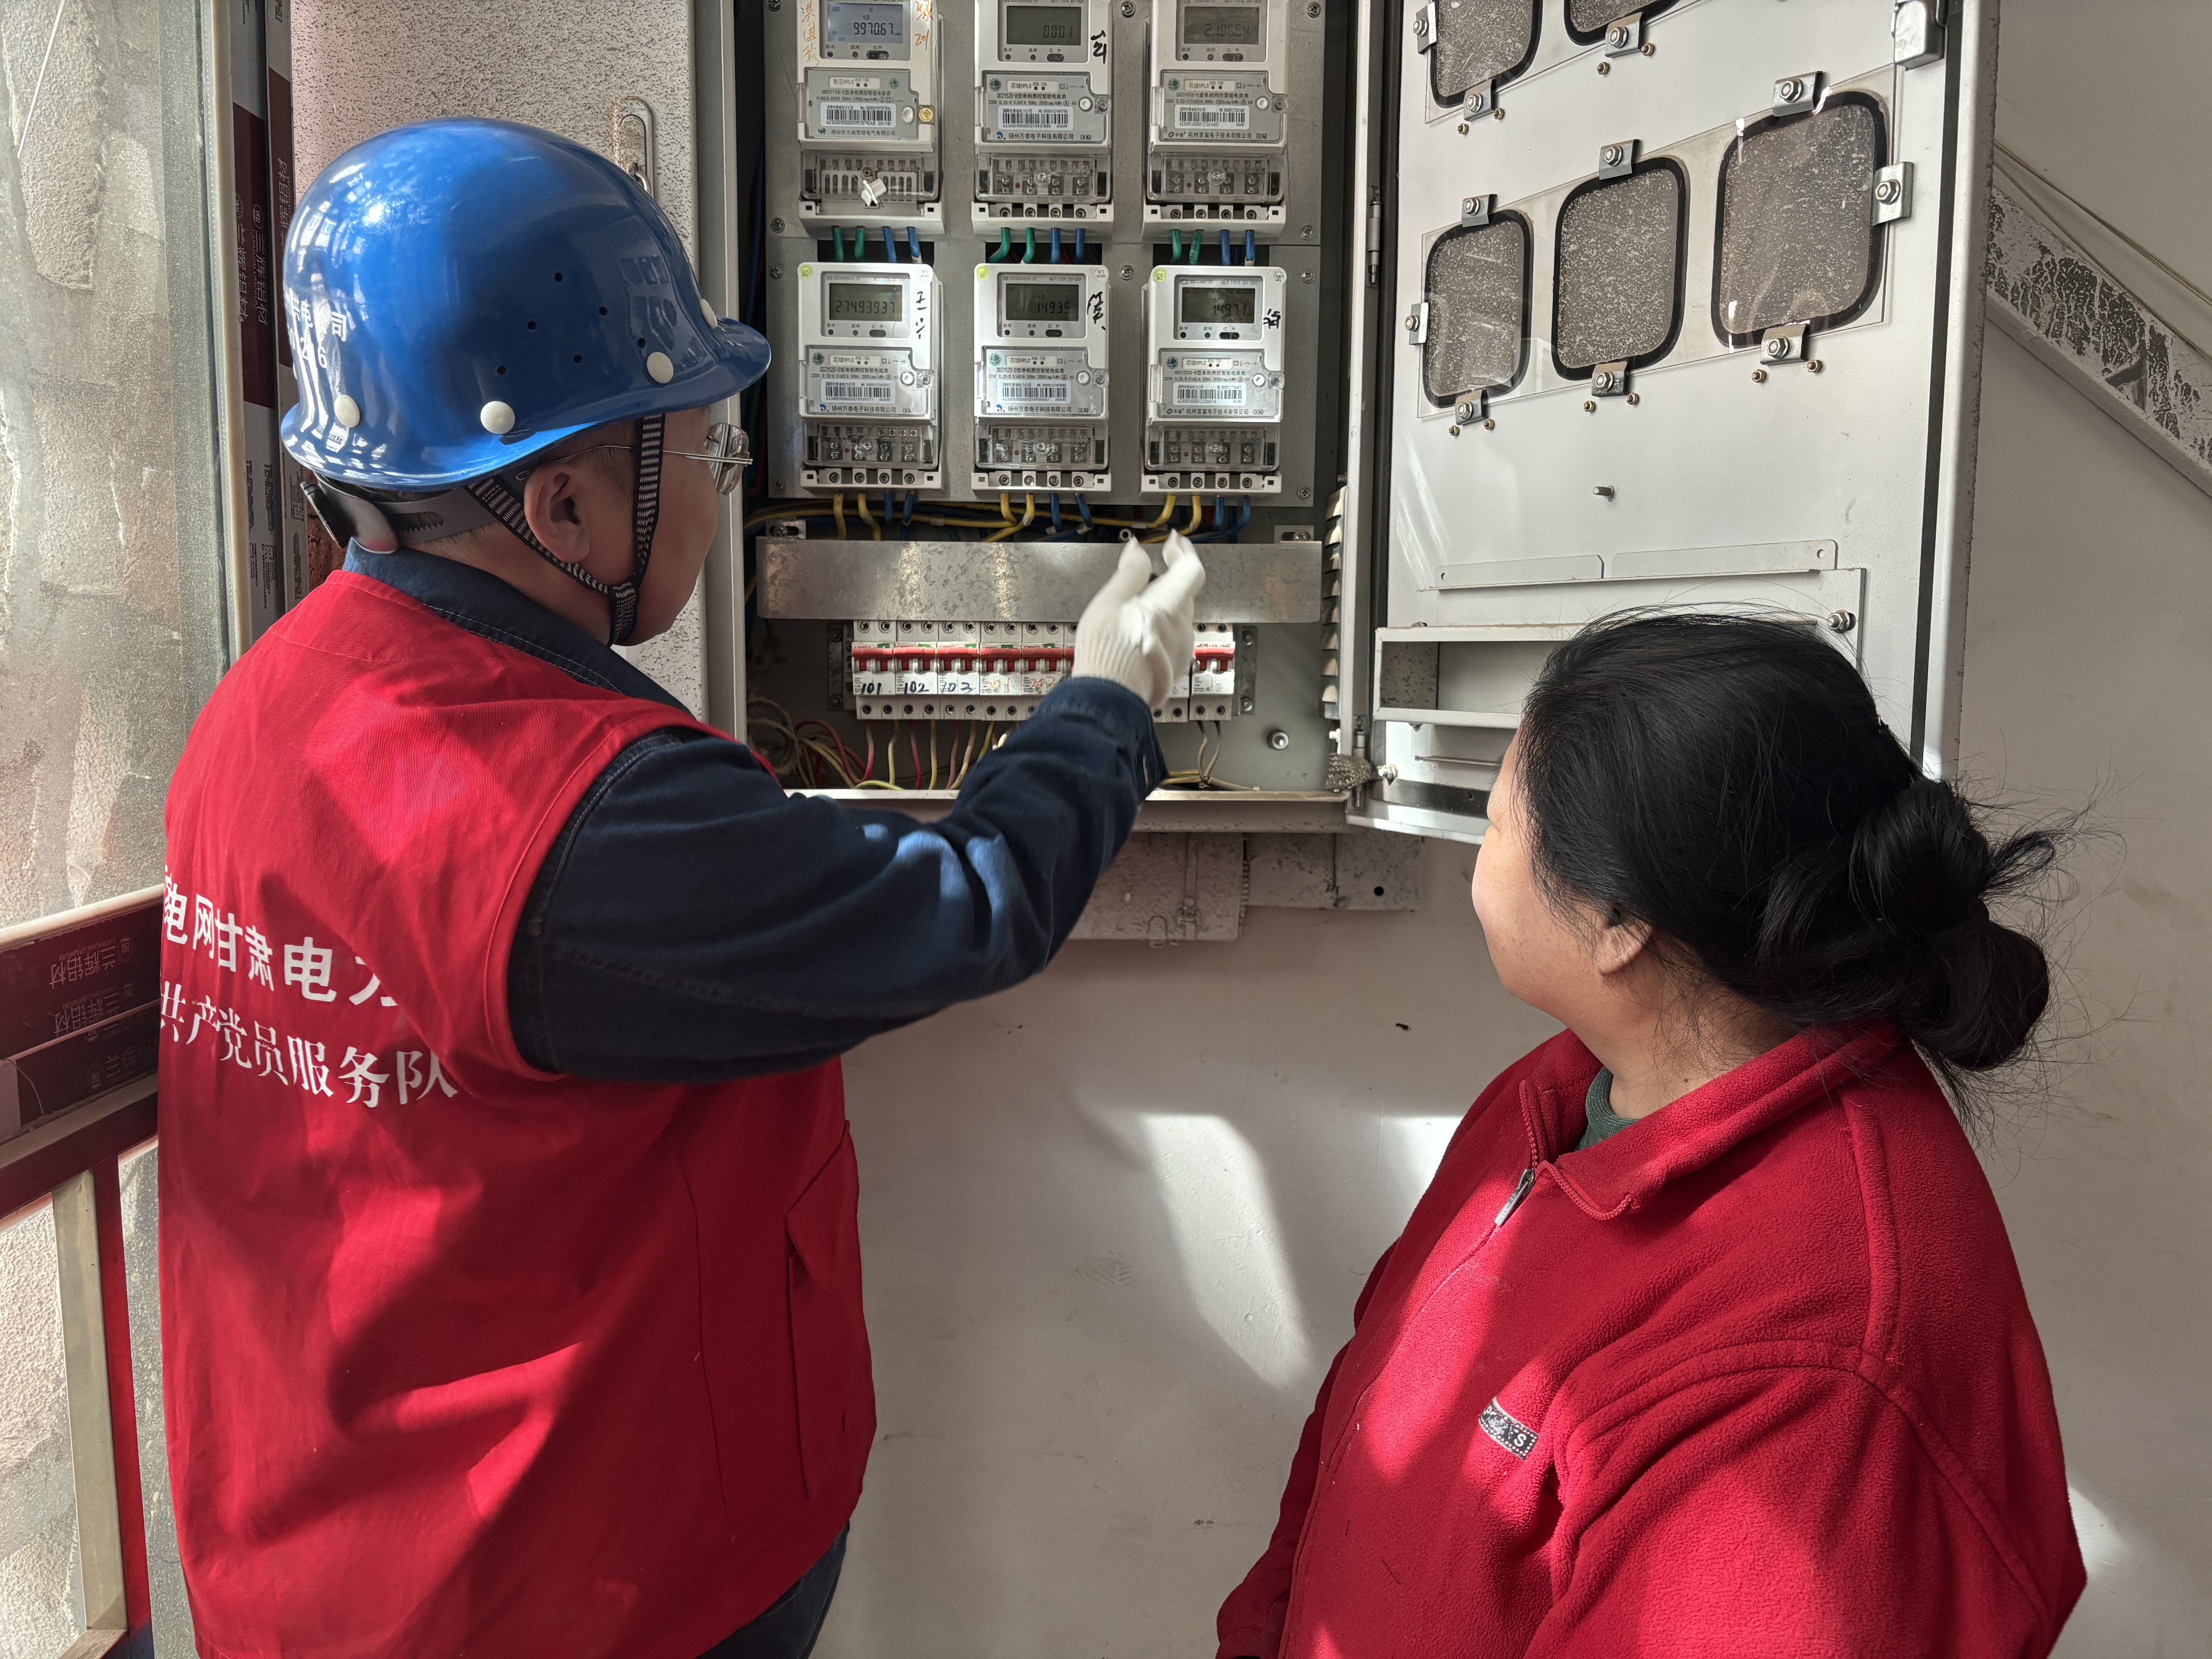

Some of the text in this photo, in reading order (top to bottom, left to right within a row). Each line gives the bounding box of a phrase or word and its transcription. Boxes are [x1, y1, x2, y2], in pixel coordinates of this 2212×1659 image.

[255, 229, 269, 327] 兰辉铝材
[289, 288, 347, 342] 供电司
[835, 301, 895, 314] 27493937
[860, 683, 882, 695] 101
[904, 682, 929, 695] 102
[163, 876, 397, 1006] 电网甘肃电
[50, 946, 117, 989] 兰辉铝材
[161, 981, 458, 1108] 共产党员服务队
